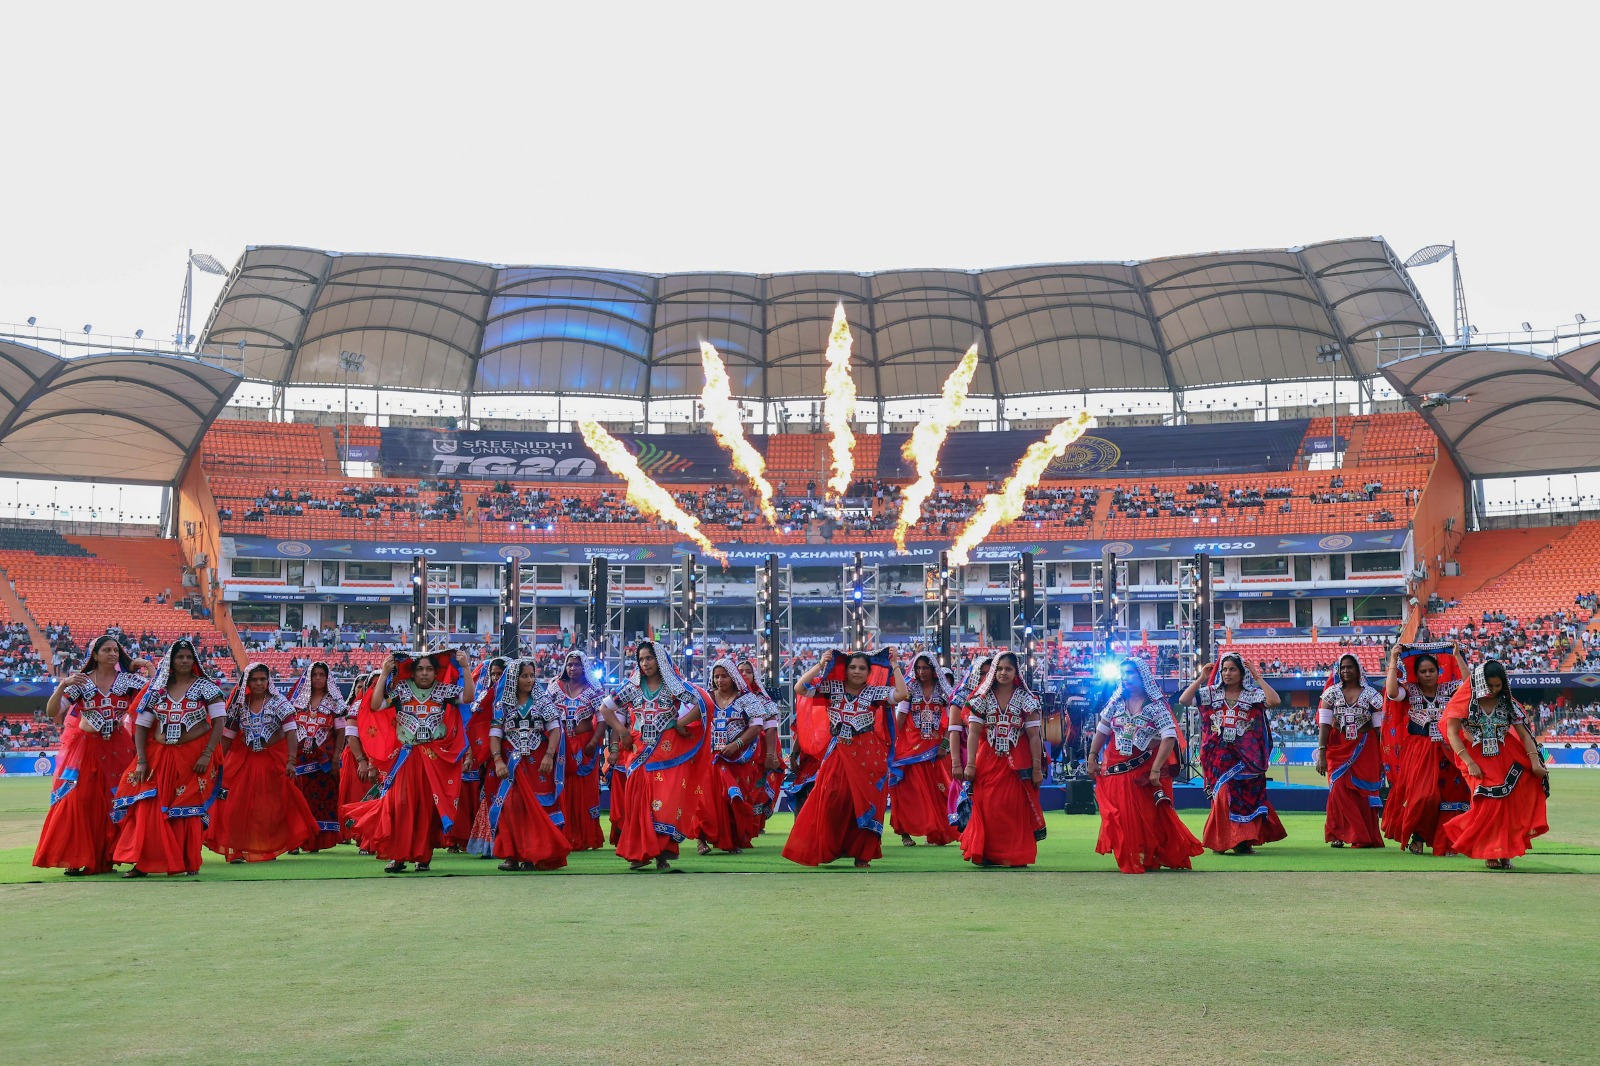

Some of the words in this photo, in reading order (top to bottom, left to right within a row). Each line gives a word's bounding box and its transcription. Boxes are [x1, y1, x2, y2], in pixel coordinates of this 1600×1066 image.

[462, 439, 573, 450] SREENIDHI
[433, 455, 597, 477] TG20
[1193, 541, 1256, 550] #TG20
[375, 547, 437, 555] #TG20
[1540, 677, 1562, 685] 2026
